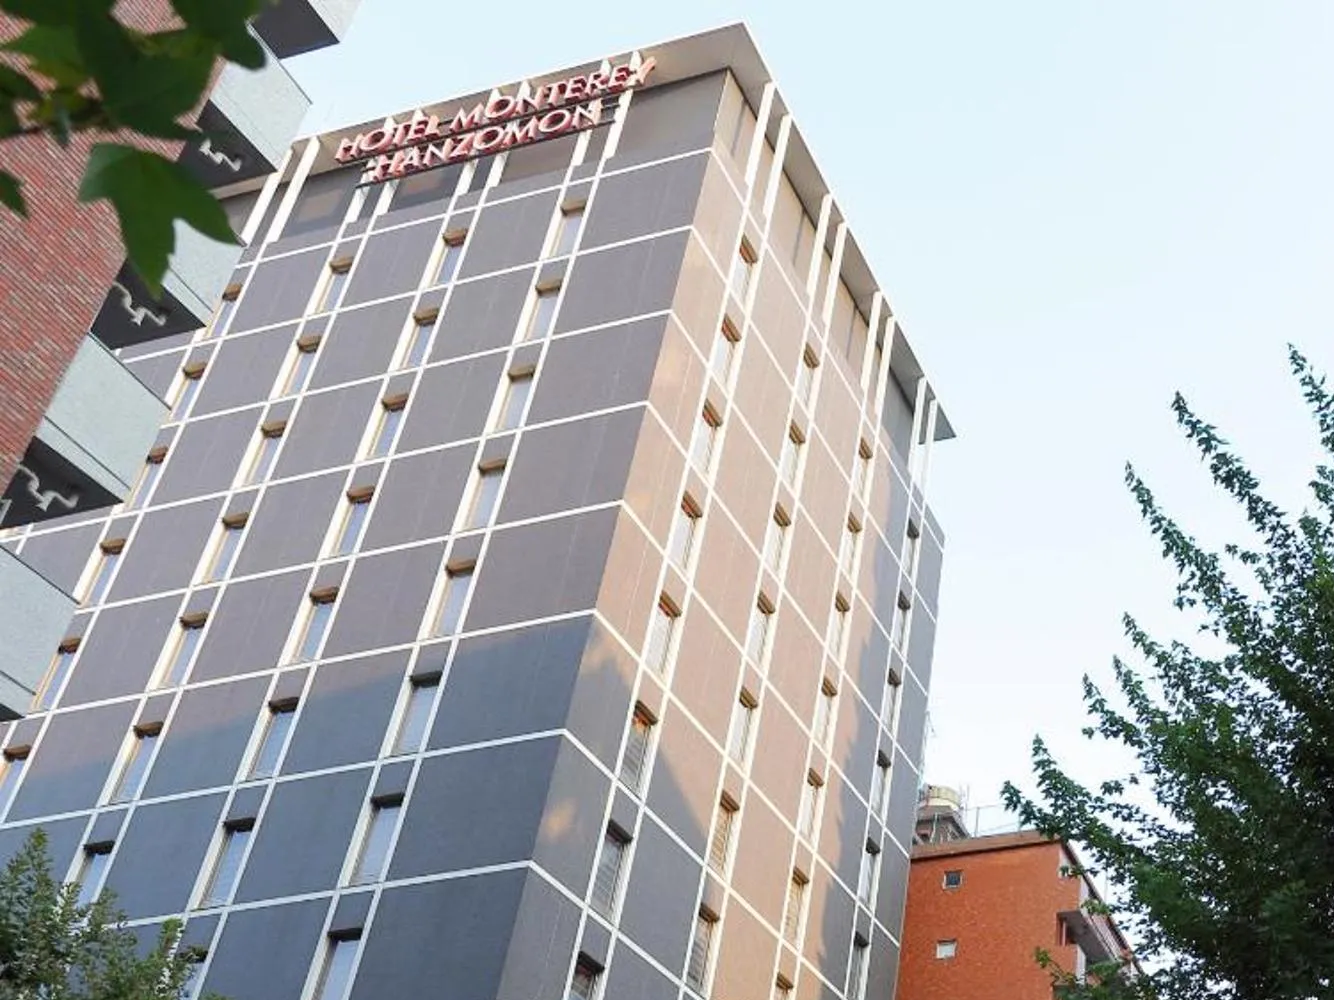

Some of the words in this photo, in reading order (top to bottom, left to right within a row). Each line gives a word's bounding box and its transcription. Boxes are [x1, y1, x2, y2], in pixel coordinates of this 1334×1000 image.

[334, 114, 440, 165] HOTEL
[449, 56, 656, 132] MONTEREY
[371, 105, 601, 183] HANZOMON
